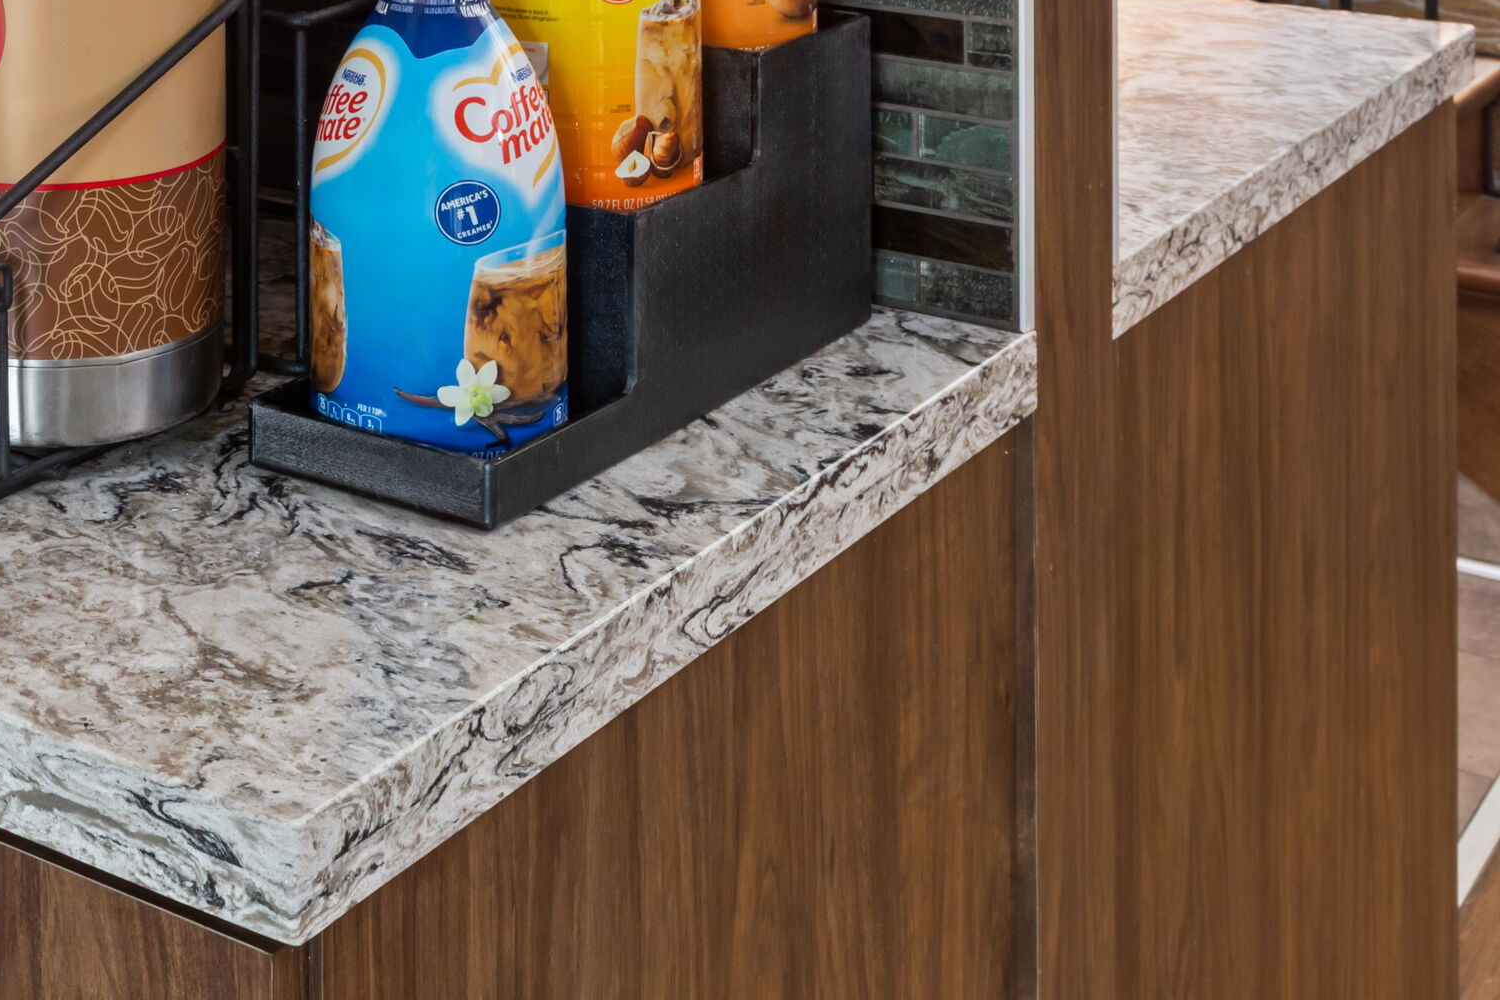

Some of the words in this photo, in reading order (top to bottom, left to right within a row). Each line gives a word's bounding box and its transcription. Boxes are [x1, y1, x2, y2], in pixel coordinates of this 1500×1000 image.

[441, 190, 489, 211] AMERICA'S
[612, 200, 621, 210] FL
[623, 200, 635, 210] OZ
[456, 205, 479, 226] #1
